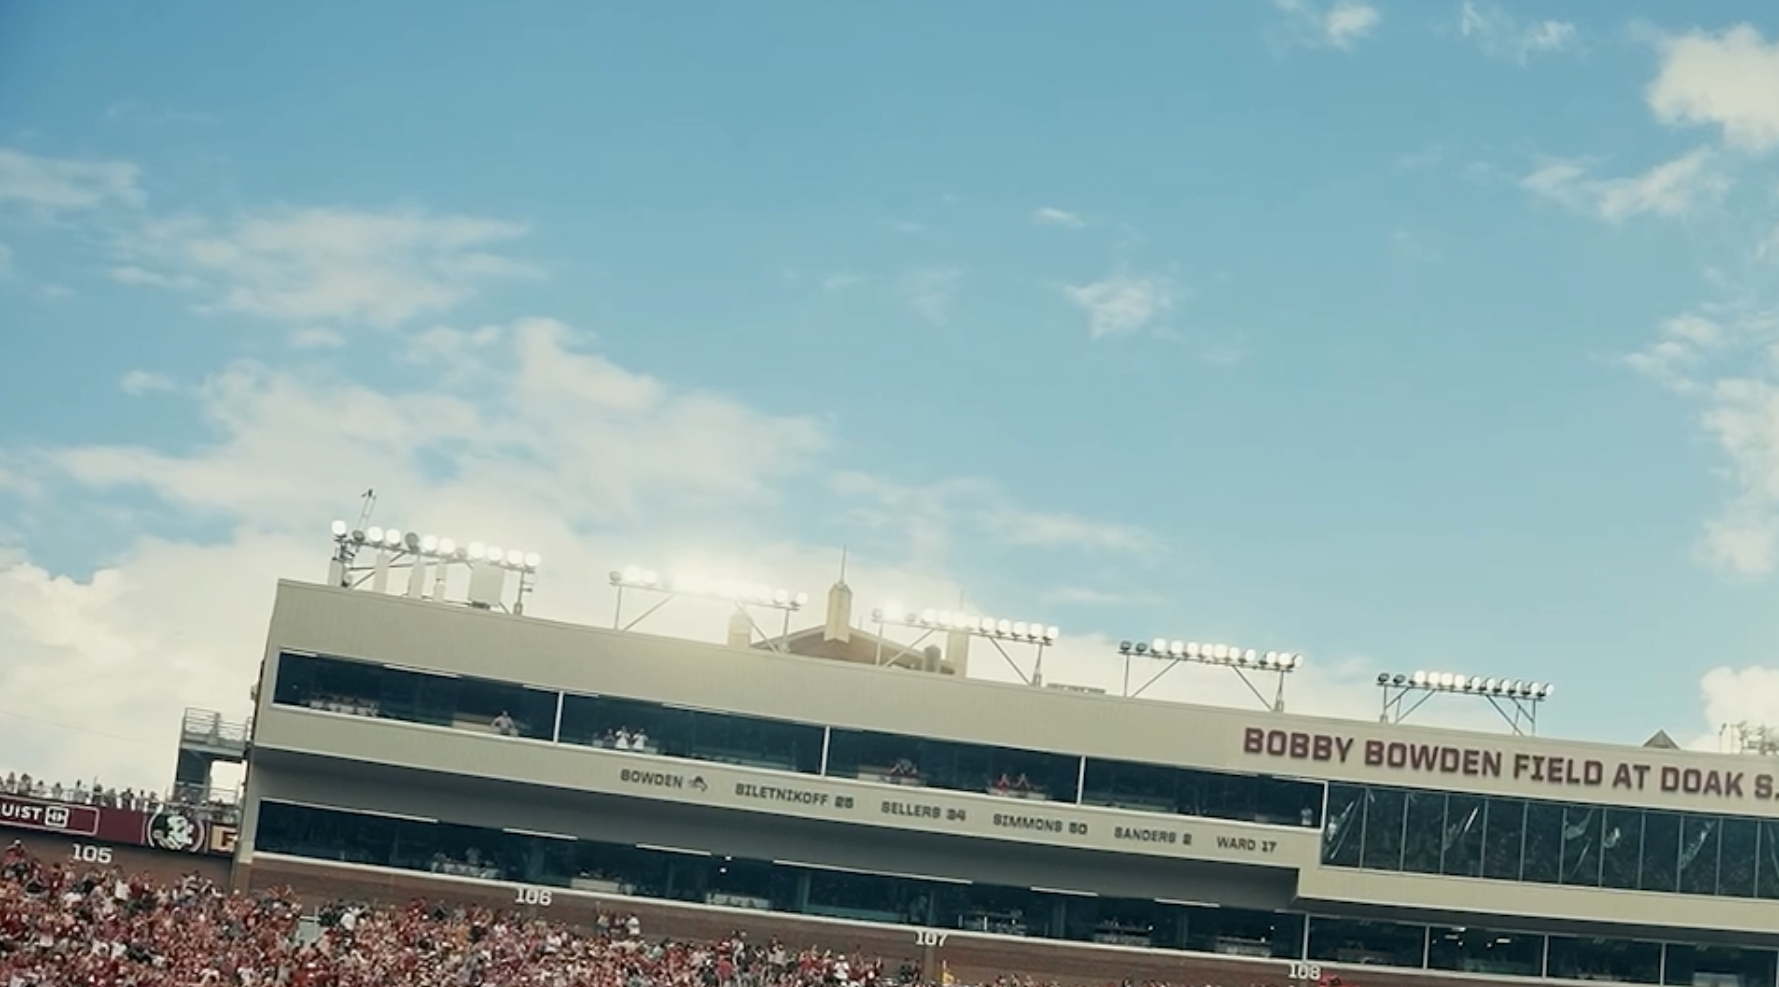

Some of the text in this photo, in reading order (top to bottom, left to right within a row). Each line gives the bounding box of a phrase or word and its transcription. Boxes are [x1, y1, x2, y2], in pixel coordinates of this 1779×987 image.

[1243, 727, 1354, 763] BOBBY
[1364, 739, 1502, 778] BOWDEN
[1512, 753, 1602, 786] FIELD
[1611, 764, 1650, 791] AT
[1661, 766, 1744, 797] DOAK
[620, 768, 683, 788] BOWDEN
[735, 782, 829, 806] BILETNIKOFF
[881, 801, 942, 819] SELLERS
[993, 813, 1063, 833] SIMMONS
[1114, 826, 1176, 844] SANDERS
[1216, 836, 1277, 853] WARD 17
[72, 843, 113, 864] 105
[514, 888, 552, 906] 106
[915, 930, 950, 948] 107
[1288, 962, 1322, 981] 108
